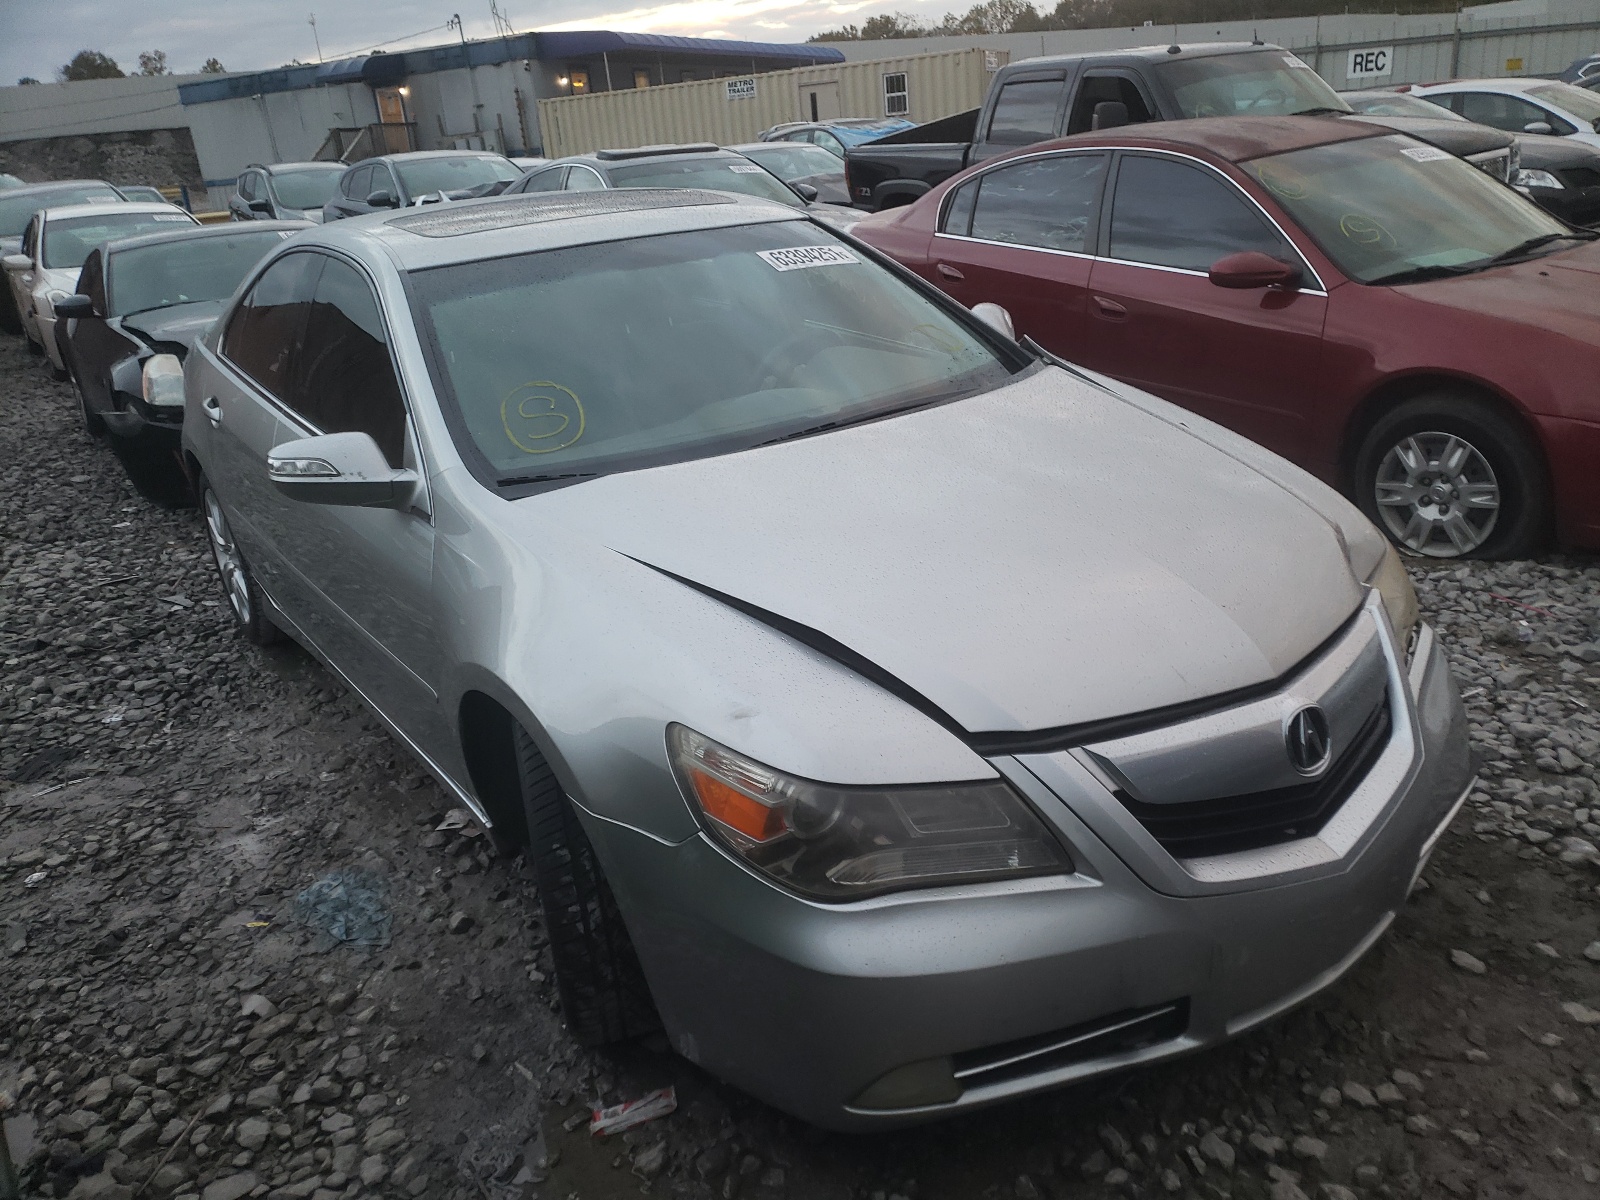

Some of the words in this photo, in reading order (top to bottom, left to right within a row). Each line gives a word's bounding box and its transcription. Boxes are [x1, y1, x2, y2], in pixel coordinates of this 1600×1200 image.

[1353, 51, 1387, 73] REC
[727, 79, 754, 88] METRO
[728, 86, 755, 94] TRAILER
[768, 247, 845, 266] 63394251
